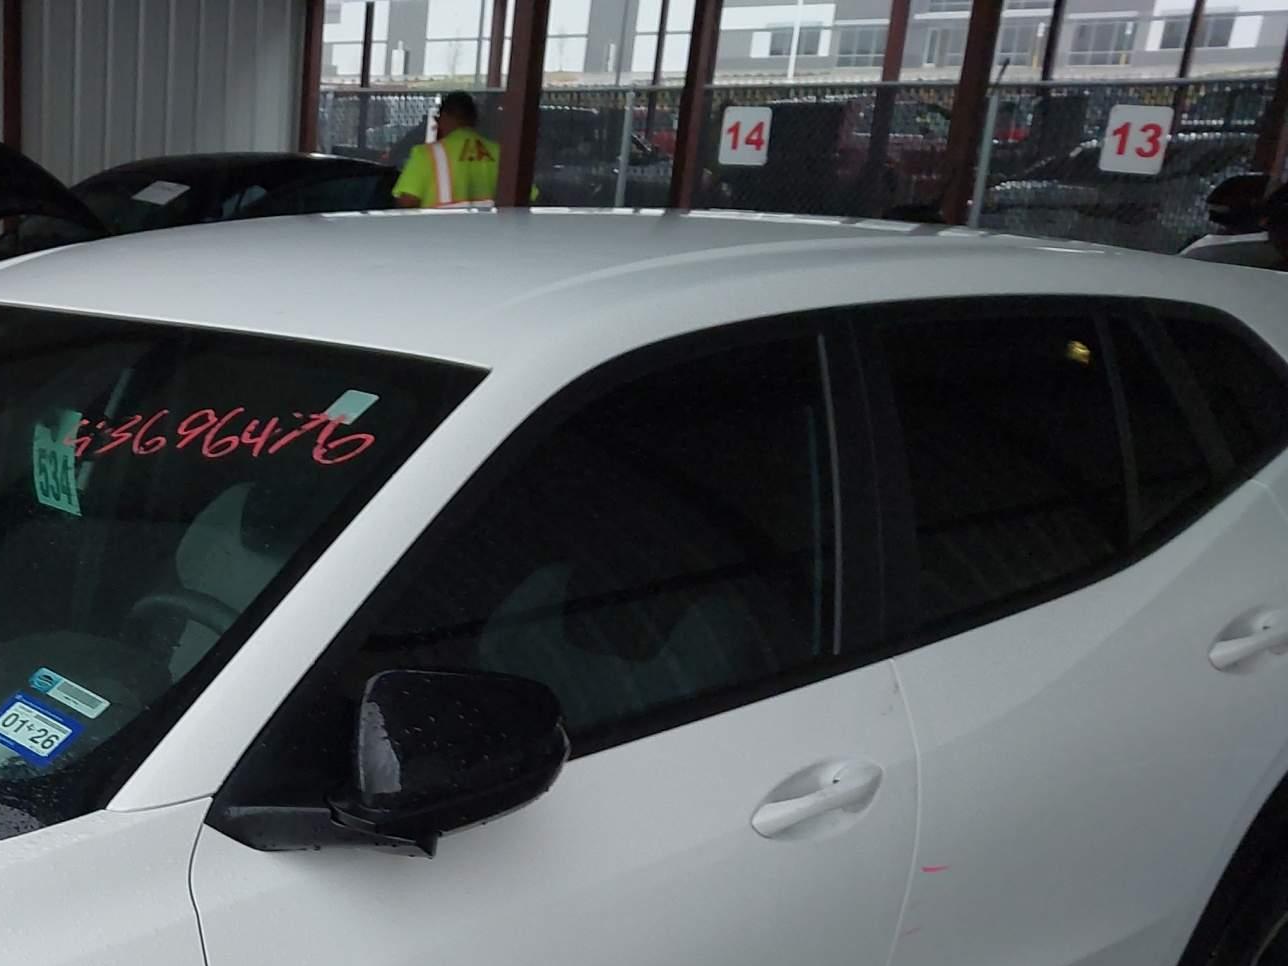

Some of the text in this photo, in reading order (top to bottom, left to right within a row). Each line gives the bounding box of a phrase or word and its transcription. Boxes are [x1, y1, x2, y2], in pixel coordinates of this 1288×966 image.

[727, 121, 765, 151] 14
[1113, 122, 1162, 157] 13
[38, 447, 75, 505] 534
